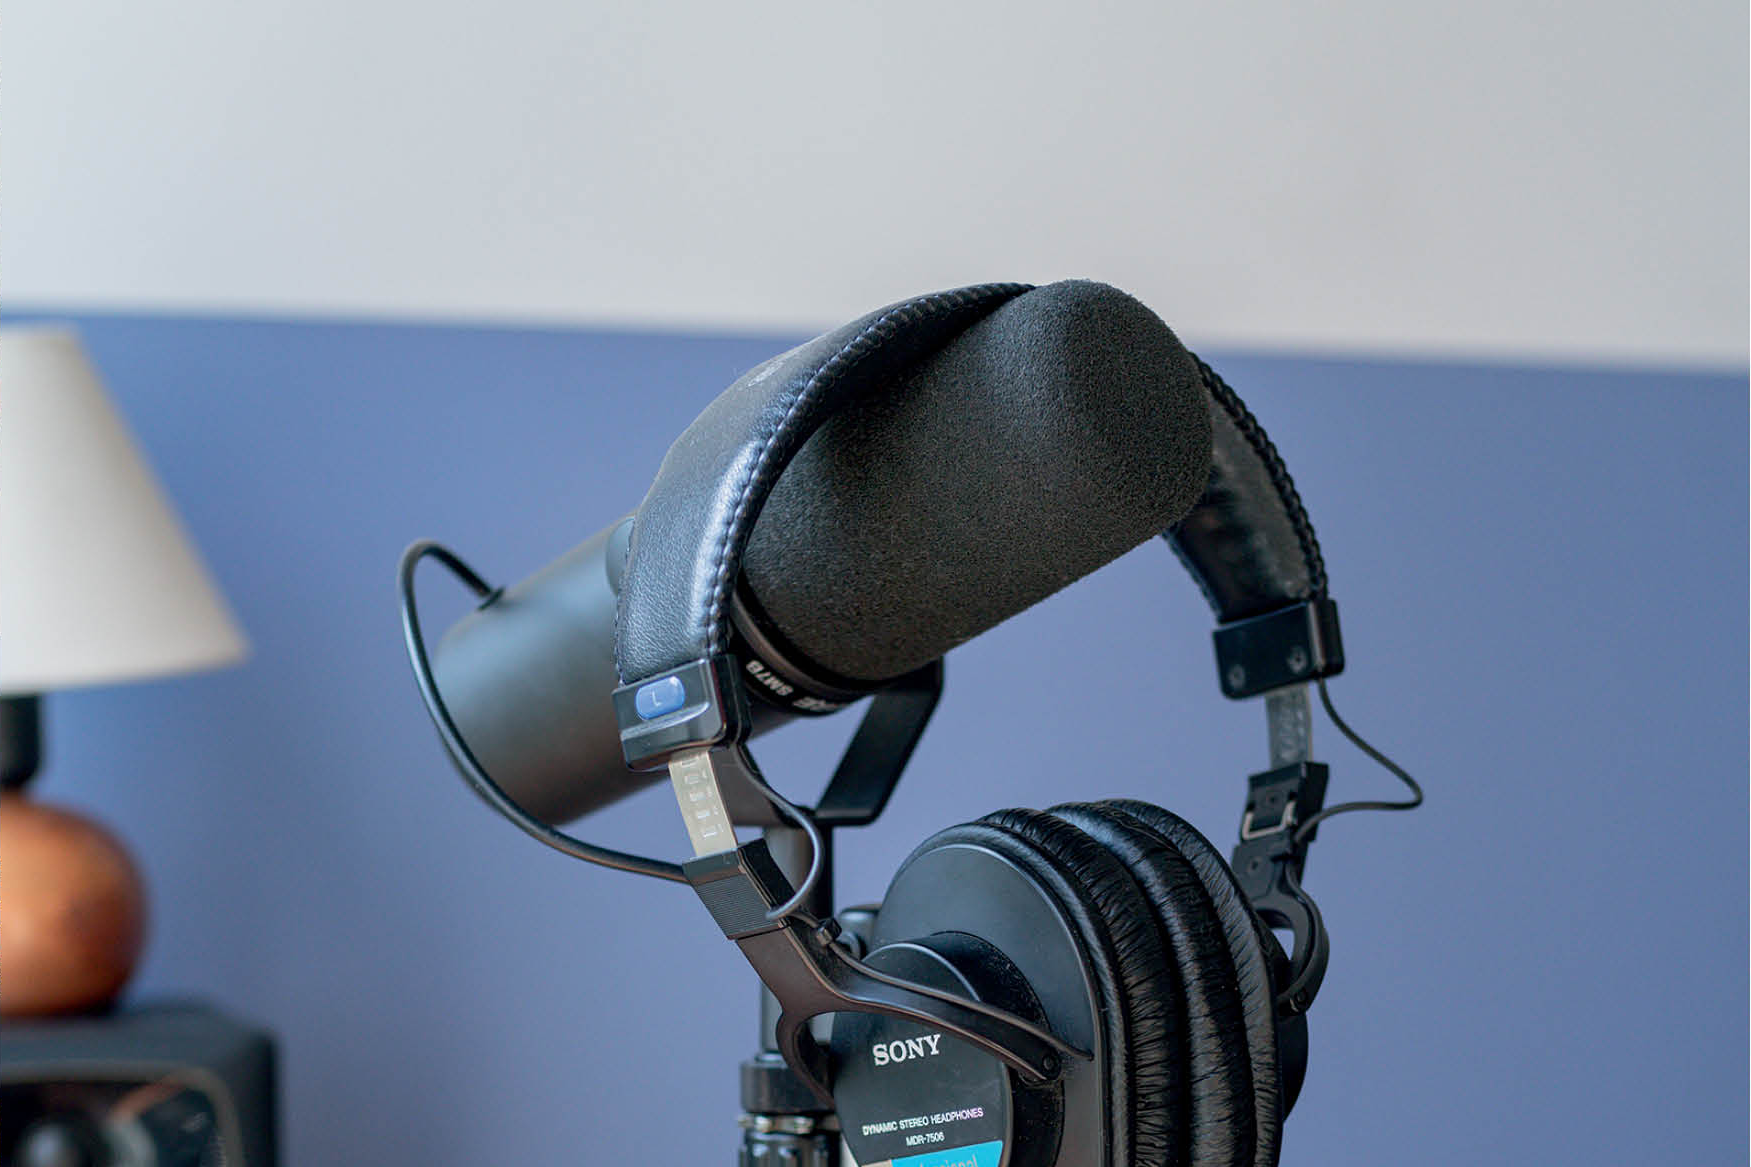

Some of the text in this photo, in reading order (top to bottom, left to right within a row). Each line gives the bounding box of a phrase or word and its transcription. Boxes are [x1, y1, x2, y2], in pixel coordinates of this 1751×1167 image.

[651, 689, 662, 706] L
[872, 1033, 941, 1066] SONY
[862, 1106, 984, 1137] DYNAMIC STEREO HEADPHONES
[906, 1130, 945, 1147] MDR-7506
